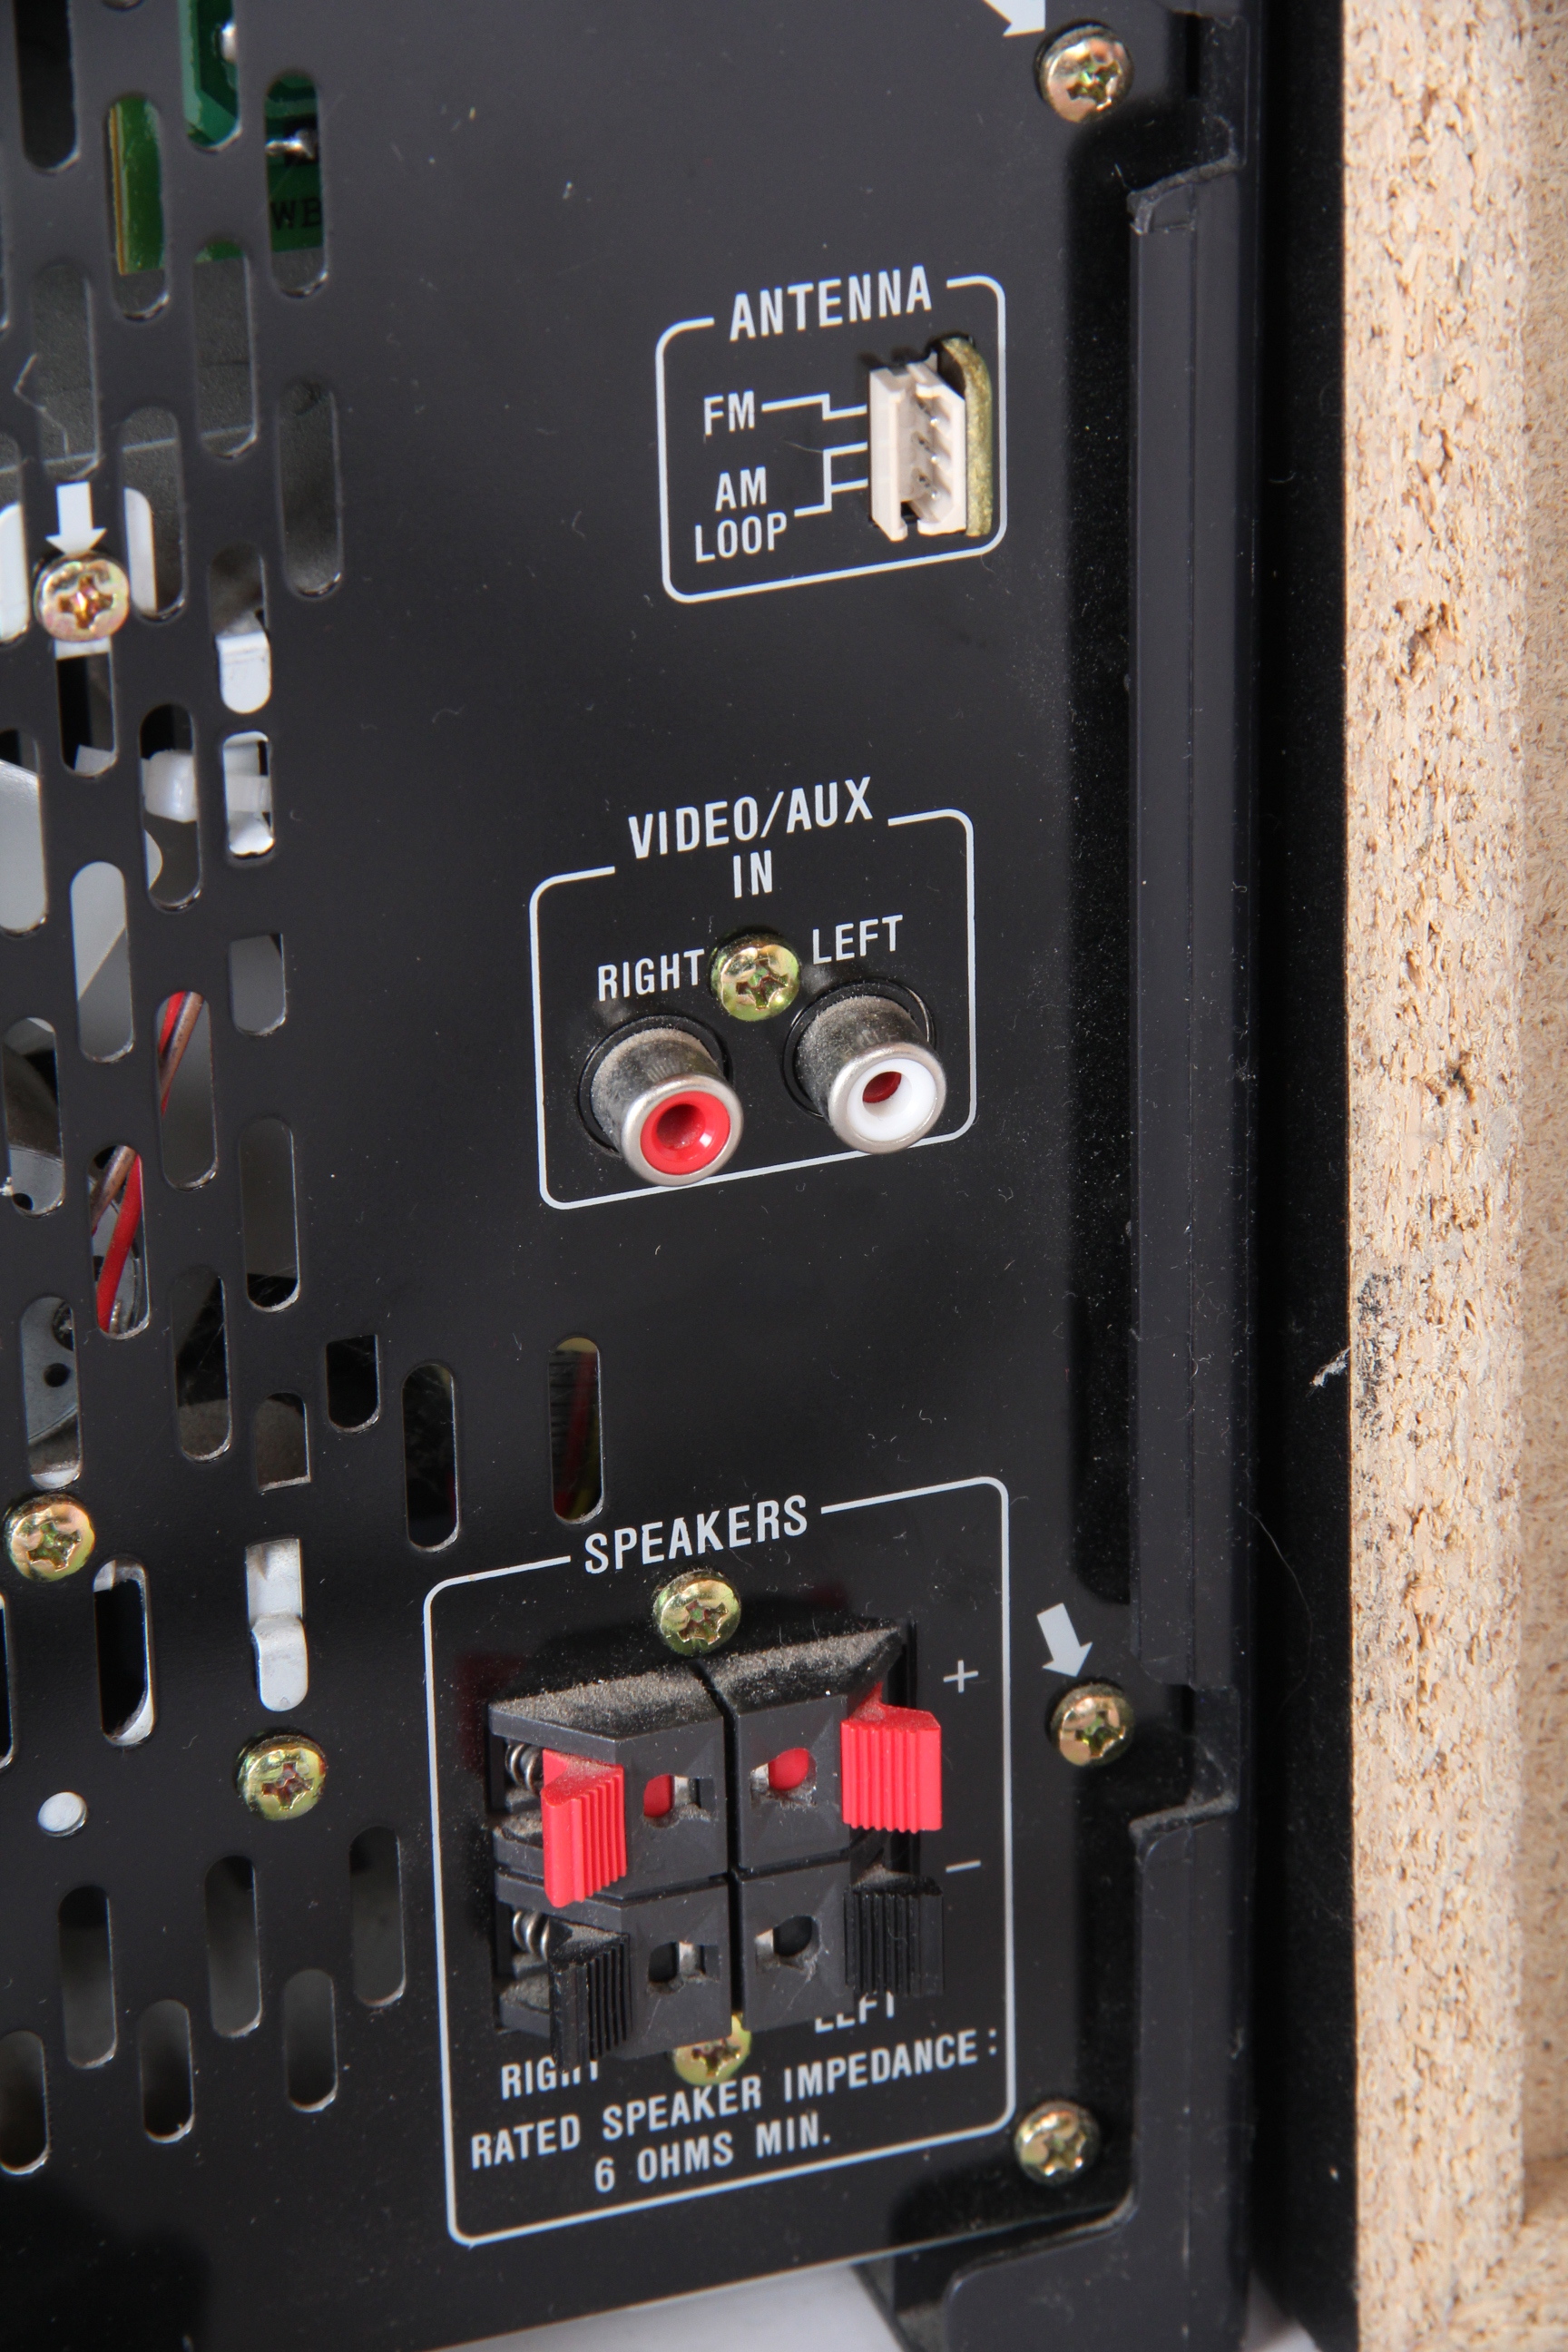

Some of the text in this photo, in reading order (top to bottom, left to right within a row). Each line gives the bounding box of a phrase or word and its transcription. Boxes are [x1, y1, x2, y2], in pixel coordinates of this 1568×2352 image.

[730, 265, 932, 342] ANTENNA
[703, 390, 755, 436] FM
[715, 466, 767, 512] AM
[694, 511, 788, 563] LOOP
[628, 776, 873, 859] VIDEO/AUX
[732, 849, 773, 898] IN
[812, 914, 904, 965] LEFT
[598, 948, 705, 1002] RIGHT
[584, 1494, 808, 1574] SPEAKERS
[471, 2114, 581, 2170] RATED
[603, 2074, 761, 2141] SPEAKER
[594, 2112, 831, 2192] 6 OHMS MIN.
